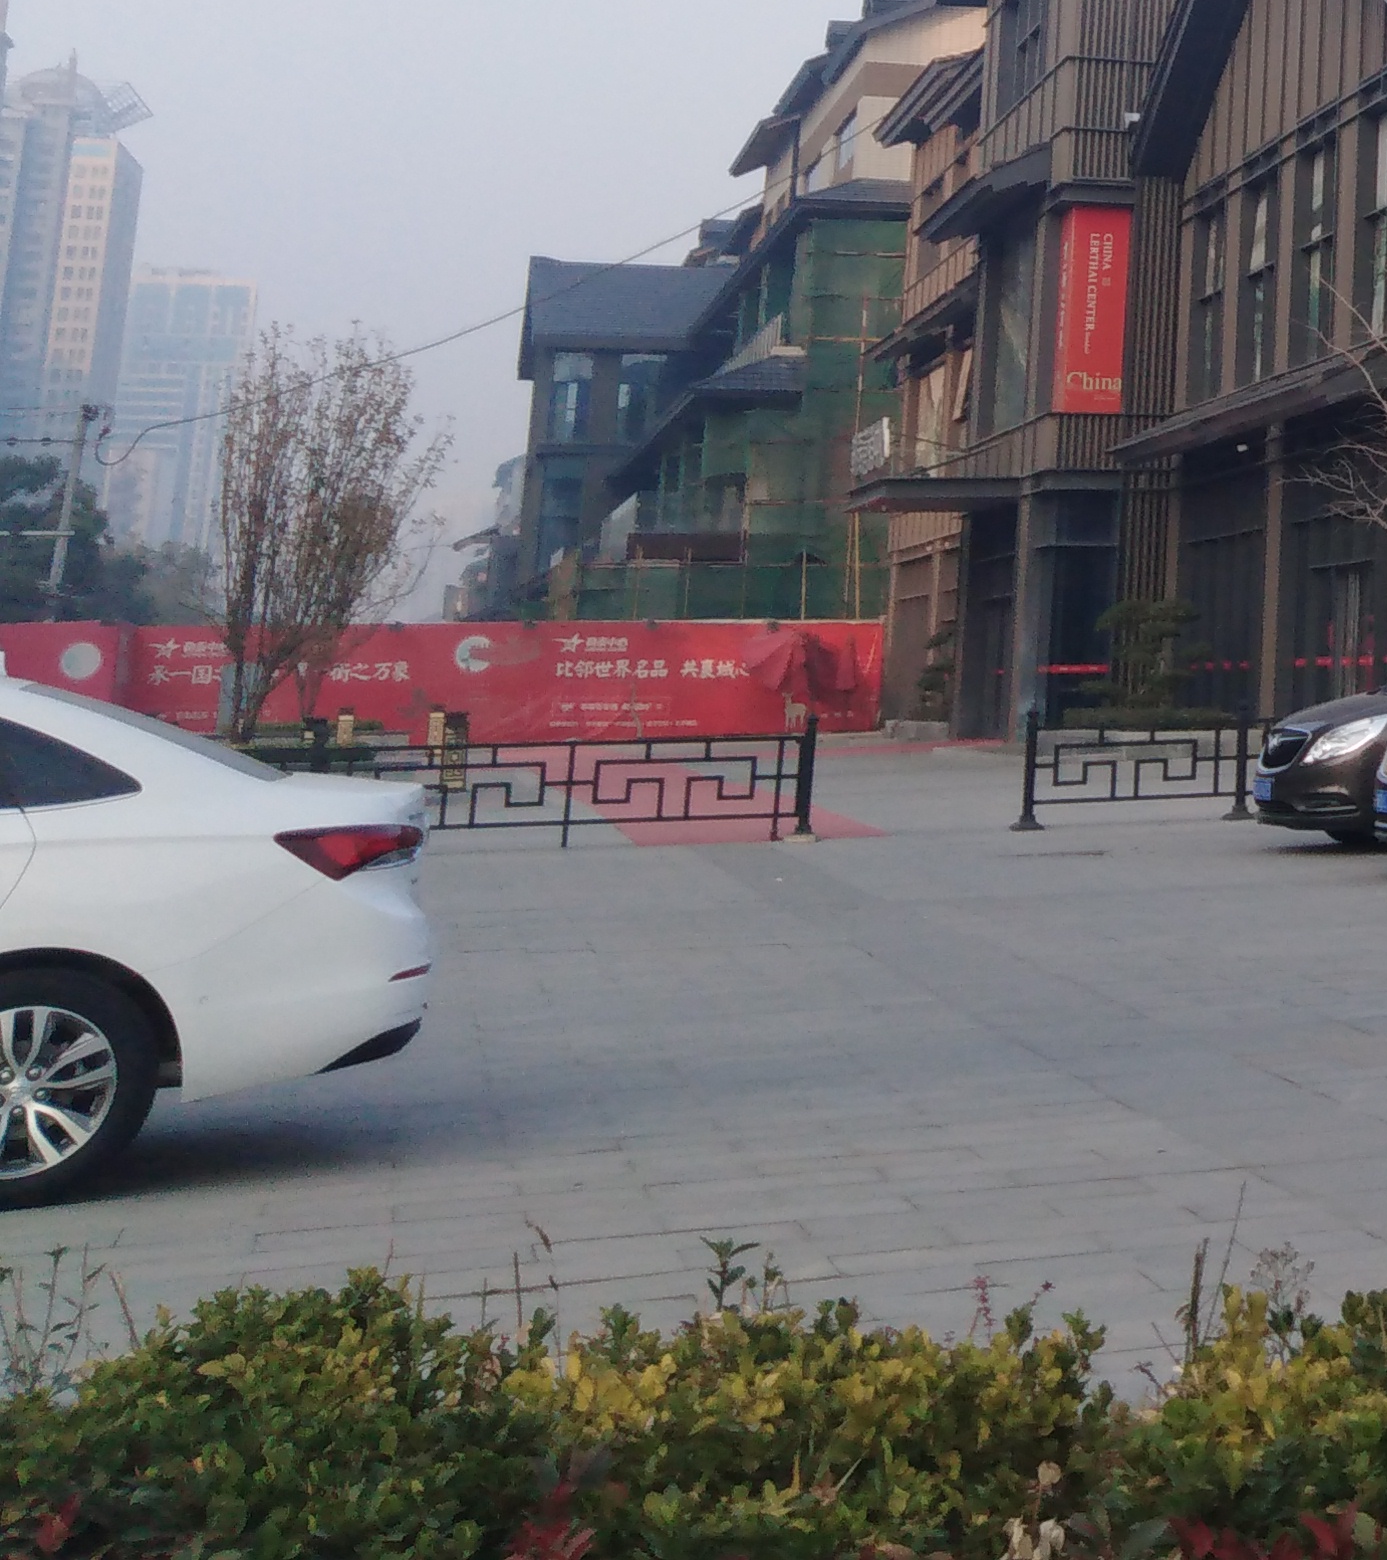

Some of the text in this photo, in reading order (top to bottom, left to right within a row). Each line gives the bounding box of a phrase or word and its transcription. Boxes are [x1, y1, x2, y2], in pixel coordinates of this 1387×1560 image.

[1088, 233, 1101, 284] LERTHAI
[1102, 233, 1114, 271] CHINA
[1085, 287, 1098, 331] CENTER
[1066, 371, 1123, 391] China
